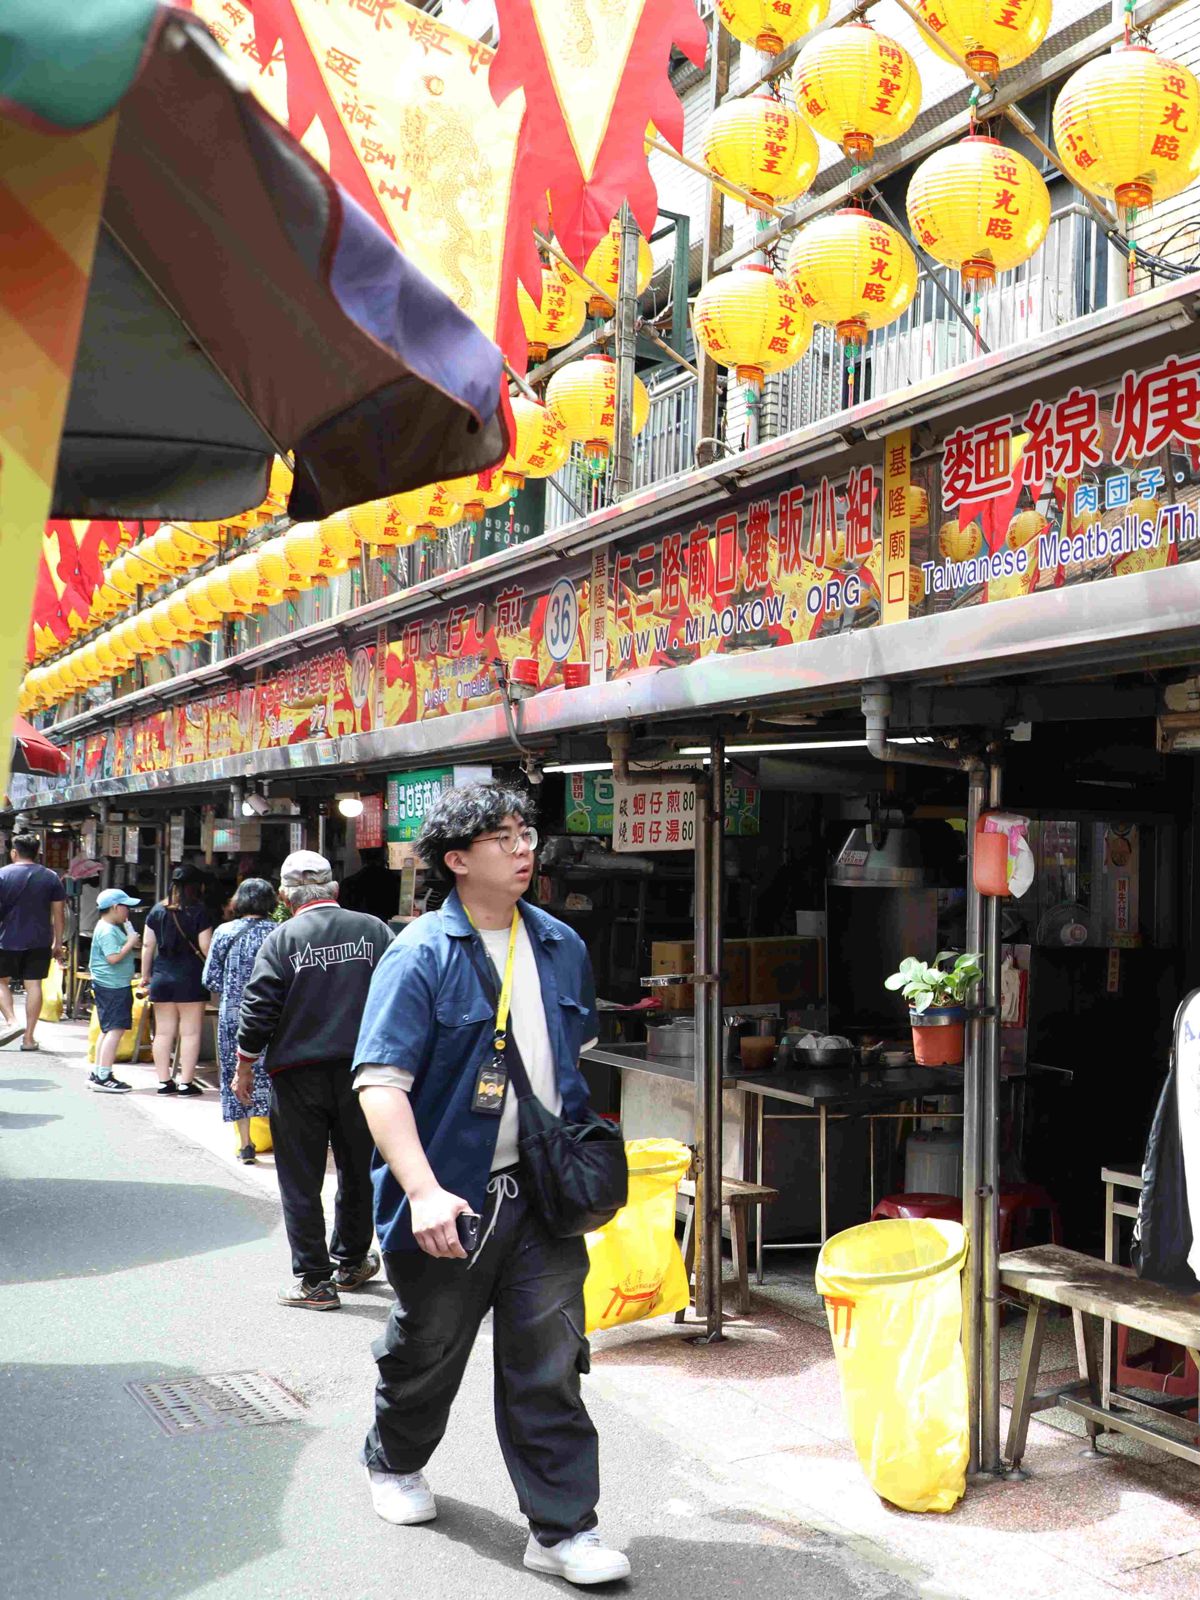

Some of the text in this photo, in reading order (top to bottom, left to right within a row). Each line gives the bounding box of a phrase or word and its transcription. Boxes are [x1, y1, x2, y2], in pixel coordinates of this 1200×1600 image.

[612, 465, 876, 622] 仁三路廟口攤販小組
[887, 444, 907, 605] 基隆廟口
[923, 553, 1027, 596] Taiwanese
[550, 593, 572, 647] 36
[632, 789, 695, 816] 蚵仔煎 80
[631, 819, 694, 844] 蚵仔湯 60
